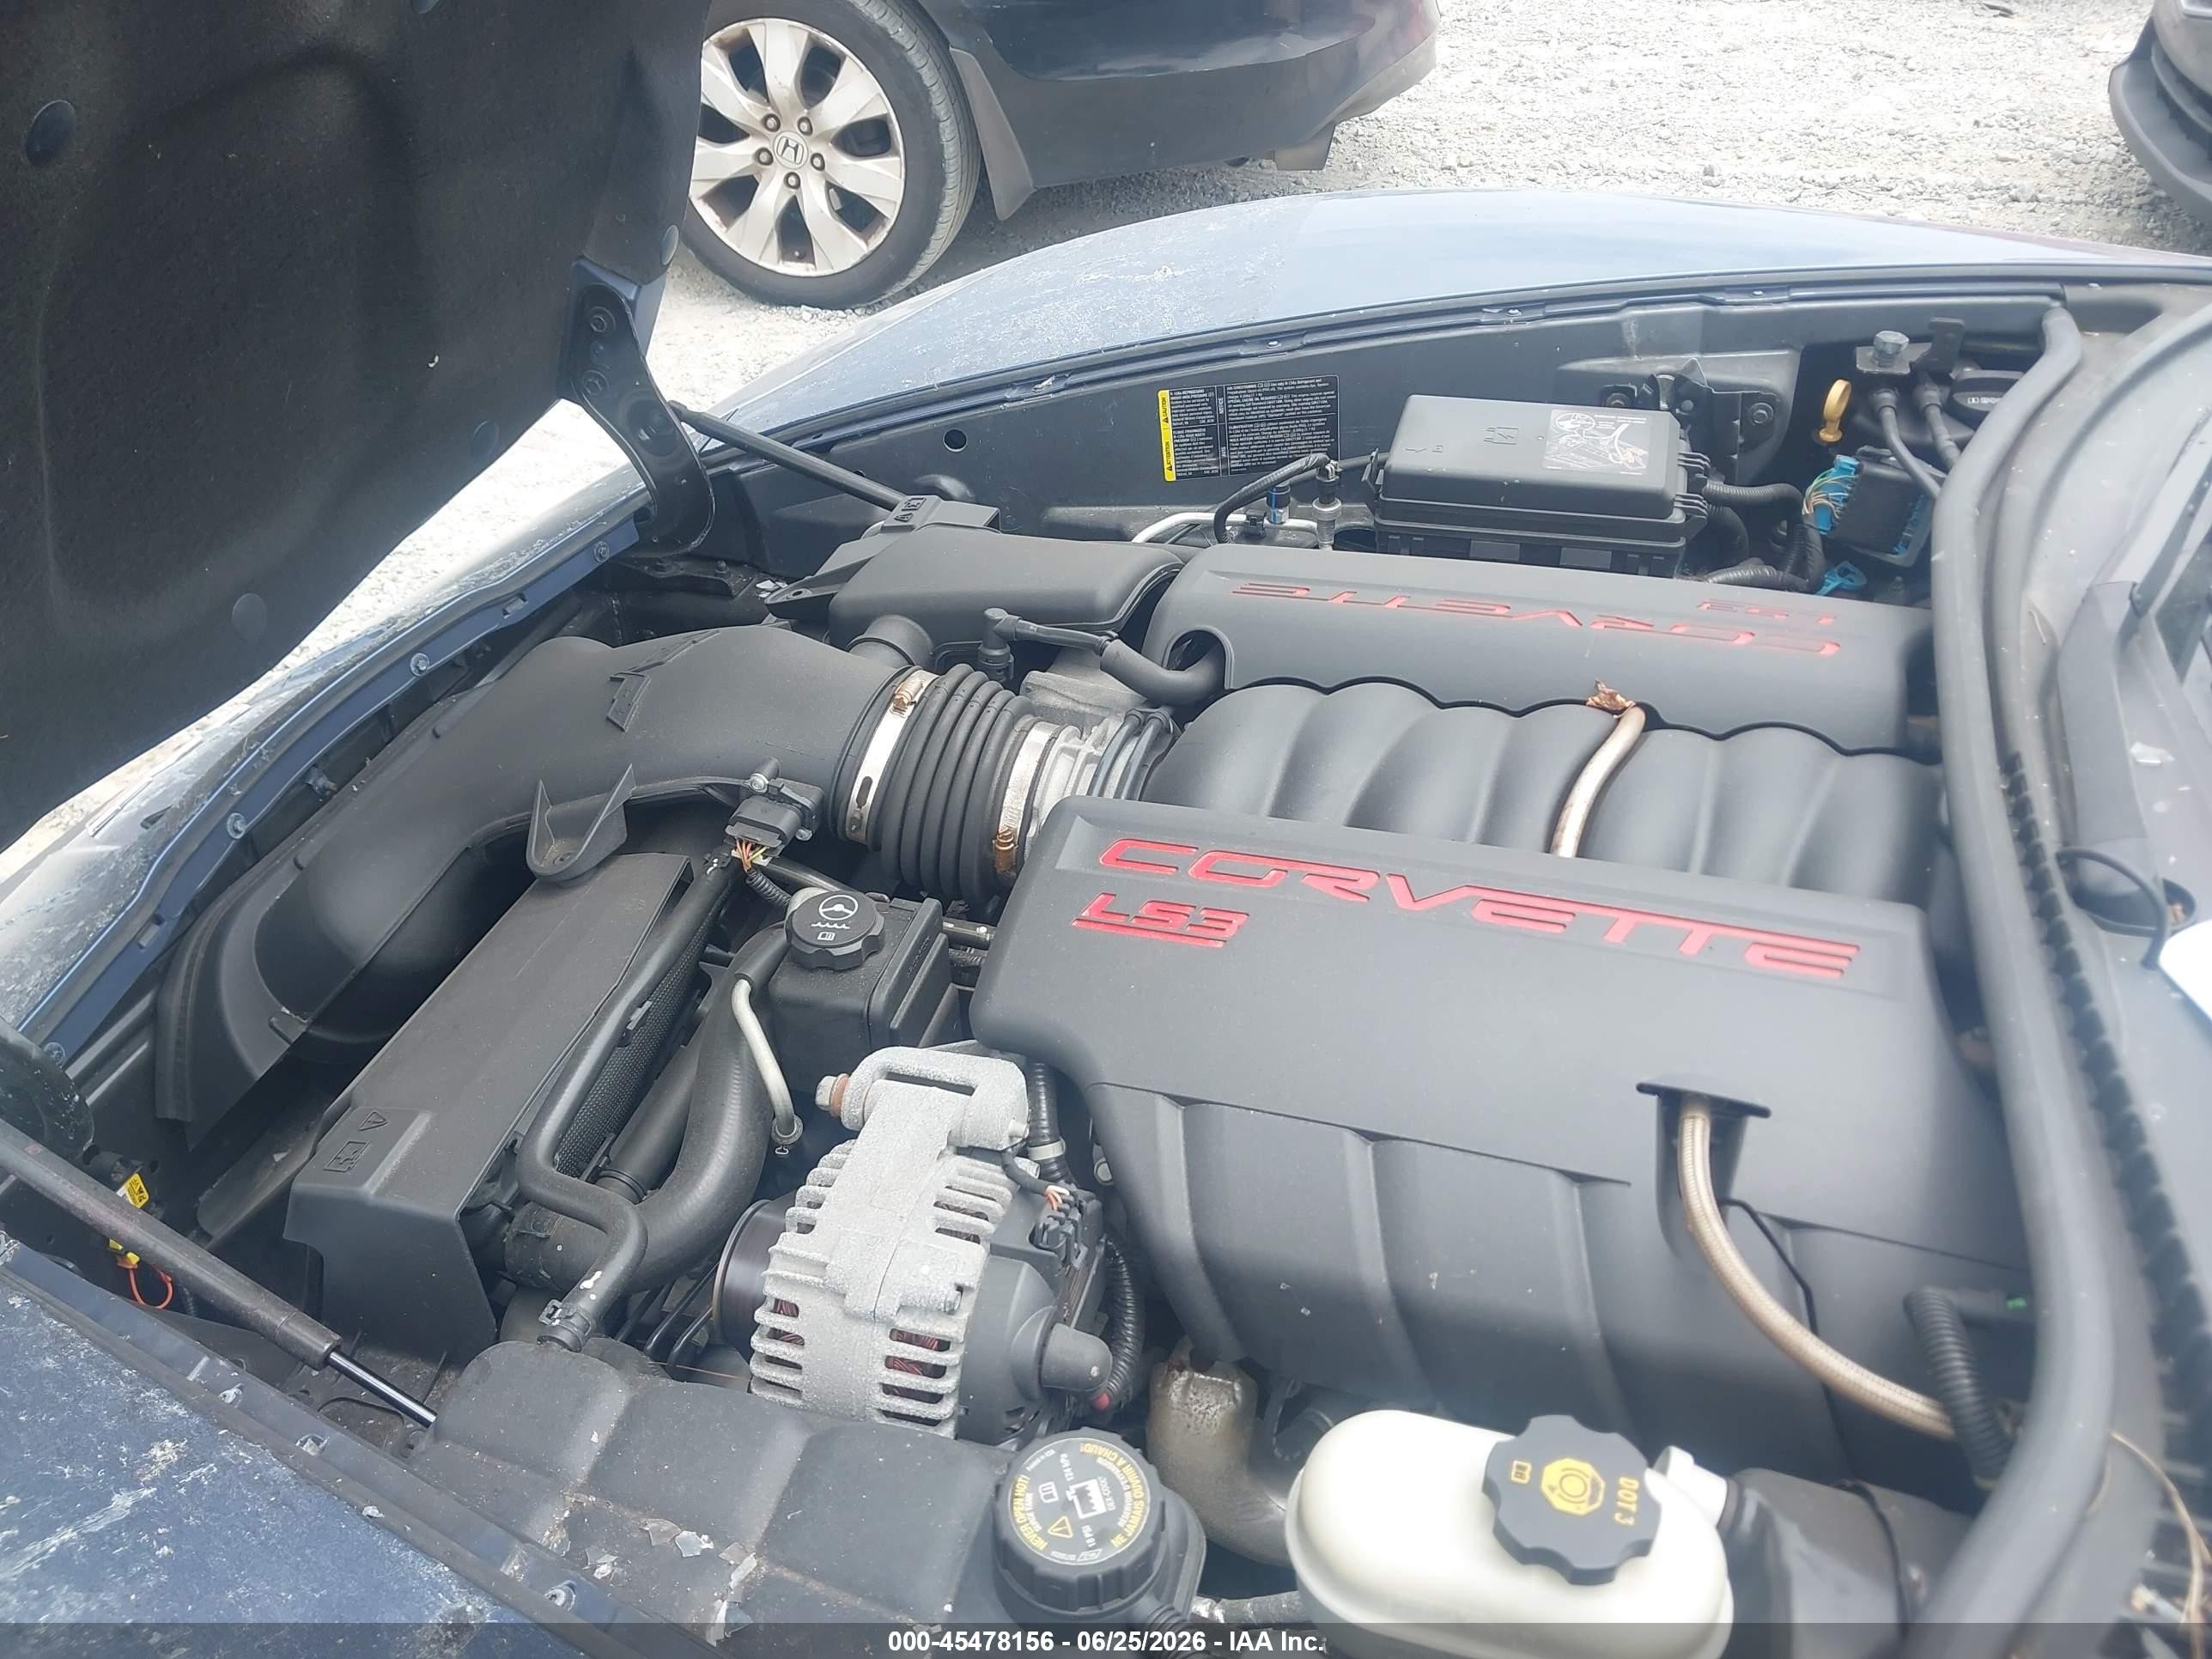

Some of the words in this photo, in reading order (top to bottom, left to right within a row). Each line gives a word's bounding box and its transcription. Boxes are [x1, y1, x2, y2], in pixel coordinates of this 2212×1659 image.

[1073, 893, 1250, 945] LS3
[1100, 838, 1861, 979] CORVETTE
[1014, 1474, 1030, 1497] HOT!
[1065, 1468, 1075, 1481] 124
[1122, 1463, 1144, 1499] OUVRIR
[1012, 1495, 1027, 1525] OPEN
[1615, 1477, 1639, 1513] DOT
[1081, 1524, 1092, 1538] PSI
[1126, 1500, 1144, 1536] JAMAIS
[1614, 1513, 1636, 1526] 3
[1018, 1521, 1048, 1550] NEVER
